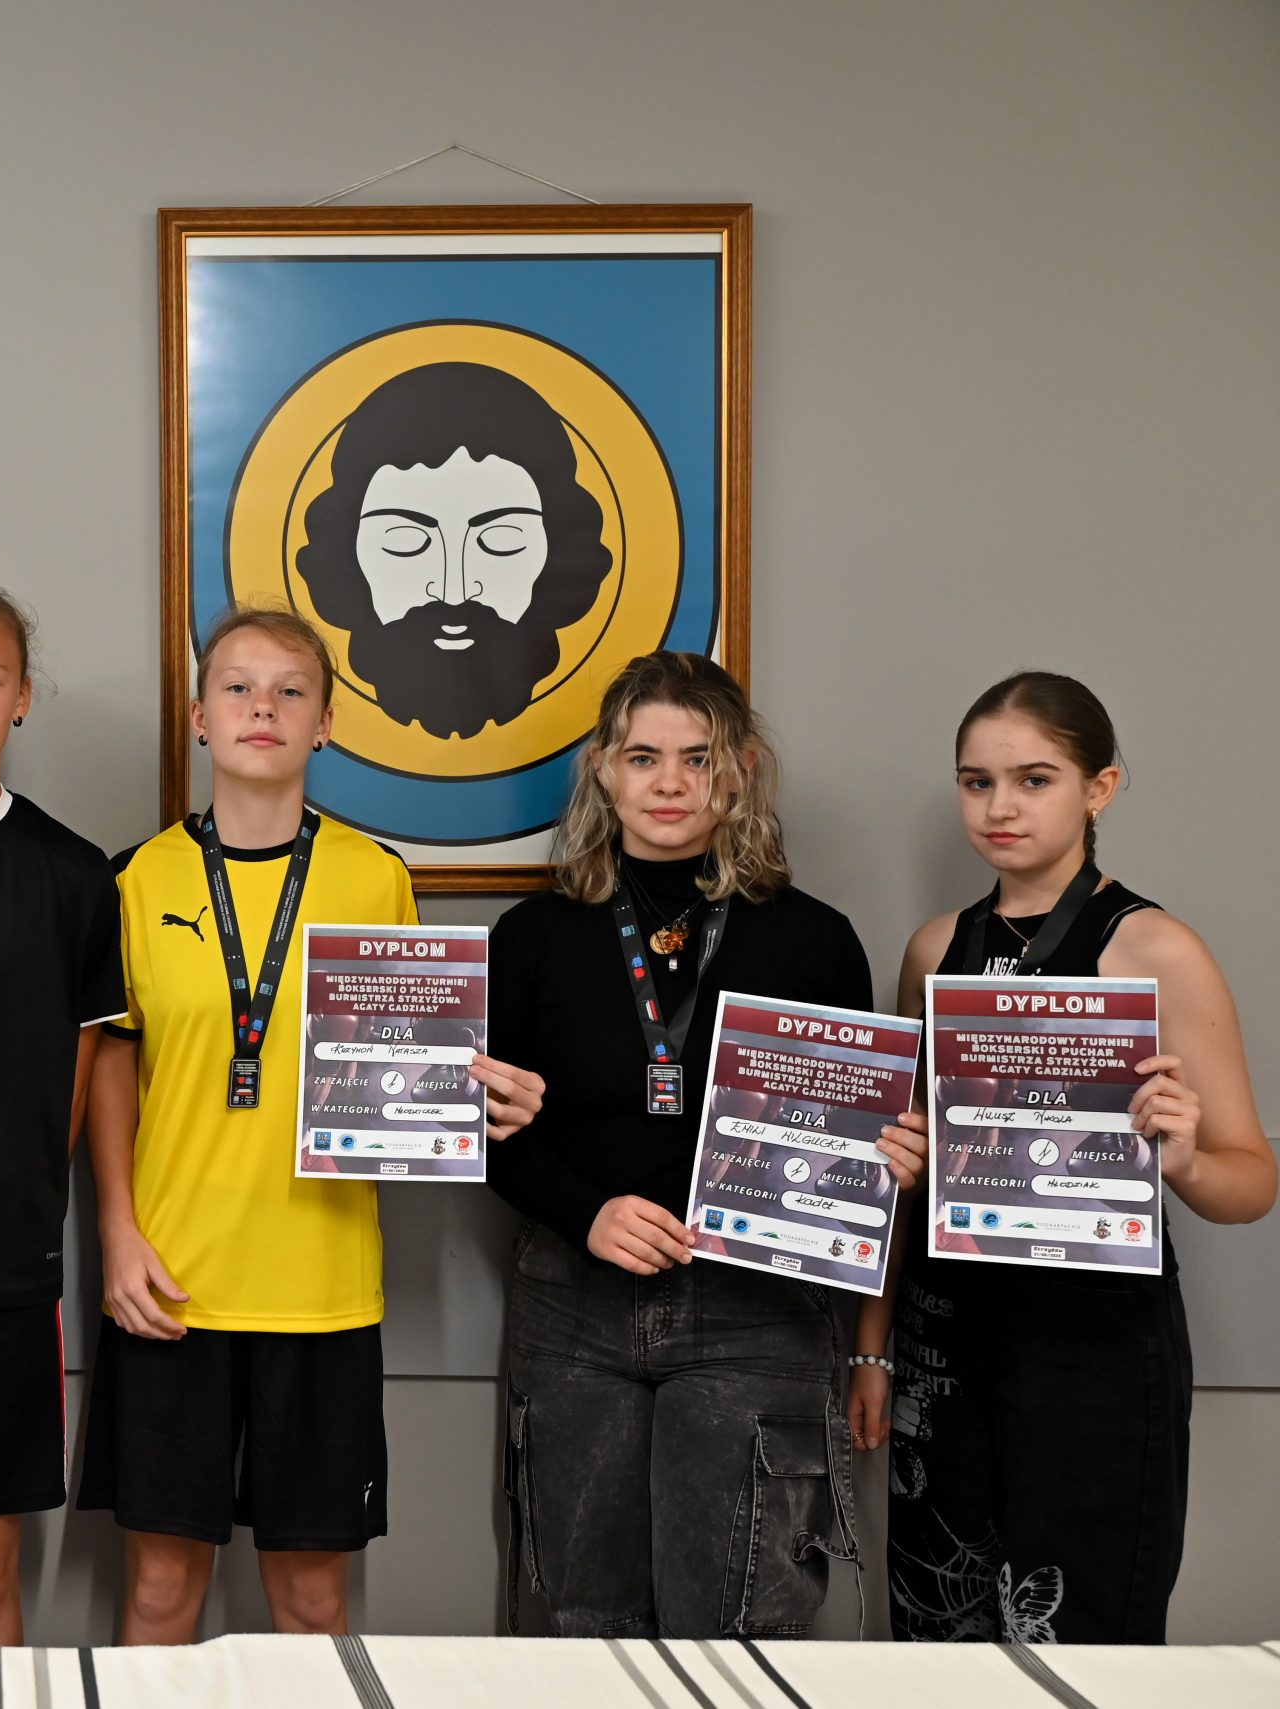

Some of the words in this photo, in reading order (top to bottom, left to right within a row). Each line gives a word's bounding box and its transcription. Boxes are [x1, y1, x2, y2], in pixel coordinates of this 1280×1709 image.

[359, 941, 446, 957] DYPLOM
[326, 975, 422, 985] MIĘDZYNARODOWY
[426, 977, 468, 987] TURNIEJ
[338, 985, 397, 993] BOKSERSKI
[329, 993, 395, 1002] BURMISTRZA
[398, 994, 461, 1004] STRZYŻOWA
[996, 994, 1105, 1014] DYPLOM
[353, 1003, 385, 1011] AGATY
[389, 1004, 439, 1012] GADZIAŁY
[381, 1026, 414, 1040] DLA
[777, 1017, 874, 1046] DYPLOM
[956, 1034, 1076, 1045] MIĘDZYNARODOWY
[1081, 1038, 1133, 1048] TURNIEJ
[972, 1044, 1044, 1054] BOKSERSKI
[1048, 1047, 1057, 1055] O
[1061, 1047, 1114, 1056] PUCHAR
[737, 1048, 843, 1072] MIĘDZYNARODOWY
[847, 1065, 893, 1082] TURNIEJ
[961, 1054, 1042, 1064] BURMISTRZA
[1046, 1056, 1126, 1068] STRZYŻOWA
[750, 1059, 813, 1077] BOKSERSKI
[817, 1070, 825, 1079] O
[828, 1070, 874, 1087] PUCHAR
[990, 1065, 1031, 1074] AGATY
[1035, 1067, 1098, 1077] GADZIAŁY
[314, 1077, 326, 1085] ZA
[330, 1077, 369, 1088] ZAJĘCIE
[416, 1080, 458, 1090] MIEJSCA
[738, 1067, 810, 1086] BURMISTRZA
[814, 1078, 883, 1098] STRZYŻOWA
[763, 1081, 799, 1093] AGATY
[802, 1087, 857, 1103] GADZIAŁY
[1027, 1091, 1068, 1106] DLA
[311, 1104, 320, 1112] W
[323, 1105, 378, 1114] KATEGORII
[790, 1109, 827, 1129] DLA
[948, 1144, 963, 1153] ZA
[967, 1144, 1014, 1156] ZAJĘCIE
[1071, 1150, 1125, 1162] MIEJSCA
[712, 1151, 727, 1162] ZA
[729, 1155, 772, 1171] ZAJĘCIE
[821, 1172, 867, 1188] MIEJSCA
[946, 1176, 958, 1184] W
[961, 1176, 1026, 1188] KATEGORII
[705, 1180, 716, 1189] W
[719, 1181, 777, 1201] KATEGORII
